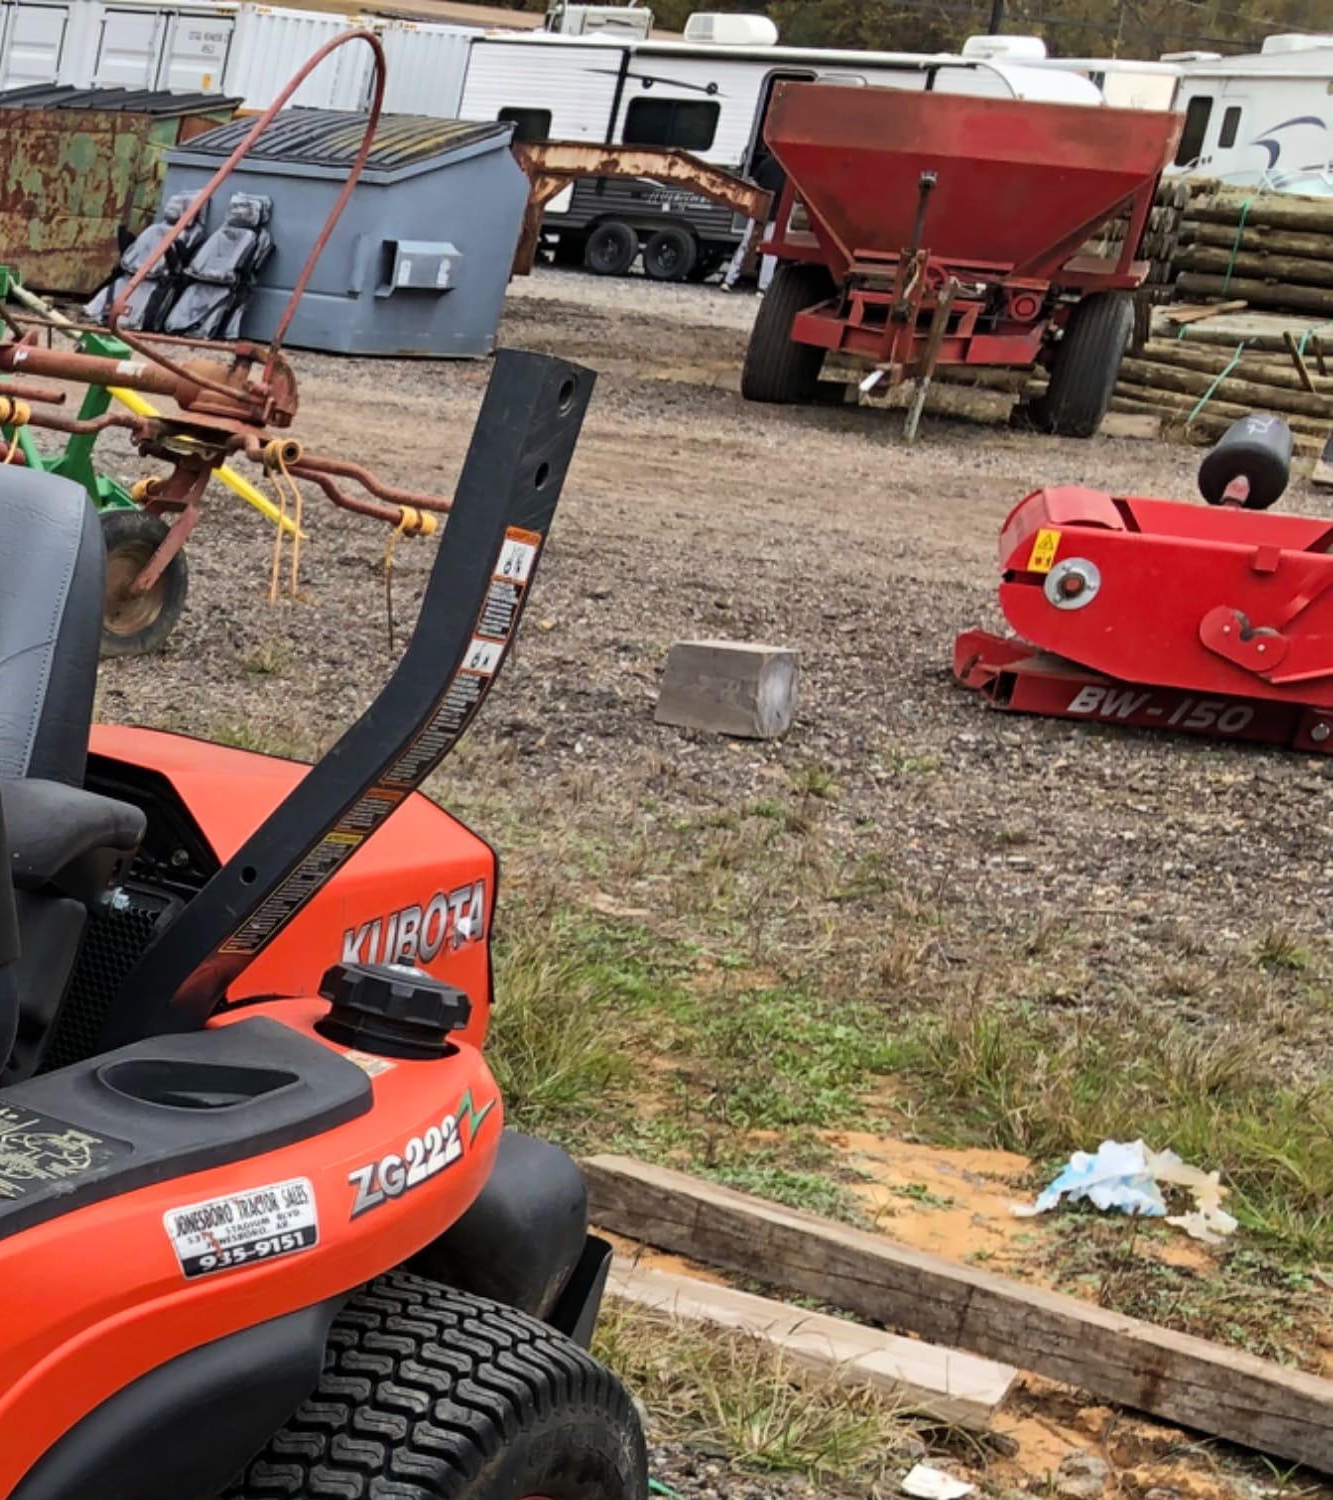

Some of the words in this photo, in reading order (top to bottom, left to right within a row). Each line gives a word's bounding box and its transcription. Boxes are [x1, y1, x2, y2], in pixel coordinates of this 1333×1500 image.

[342, 878, 486, 963] KUBOTA
[175, 1203, 234, 1237] JONESBORO
[233, 1192, 280, 1219] TRACTOR
[282, 1184, 309, 1208] SALES
[226, 1218, 270, 1234] STADIUM
[277, 1209, 300, 1221] BLVD
[276, 1220, 289, 1230] AR
[199, 1232, 305, 1270] 935-9151
